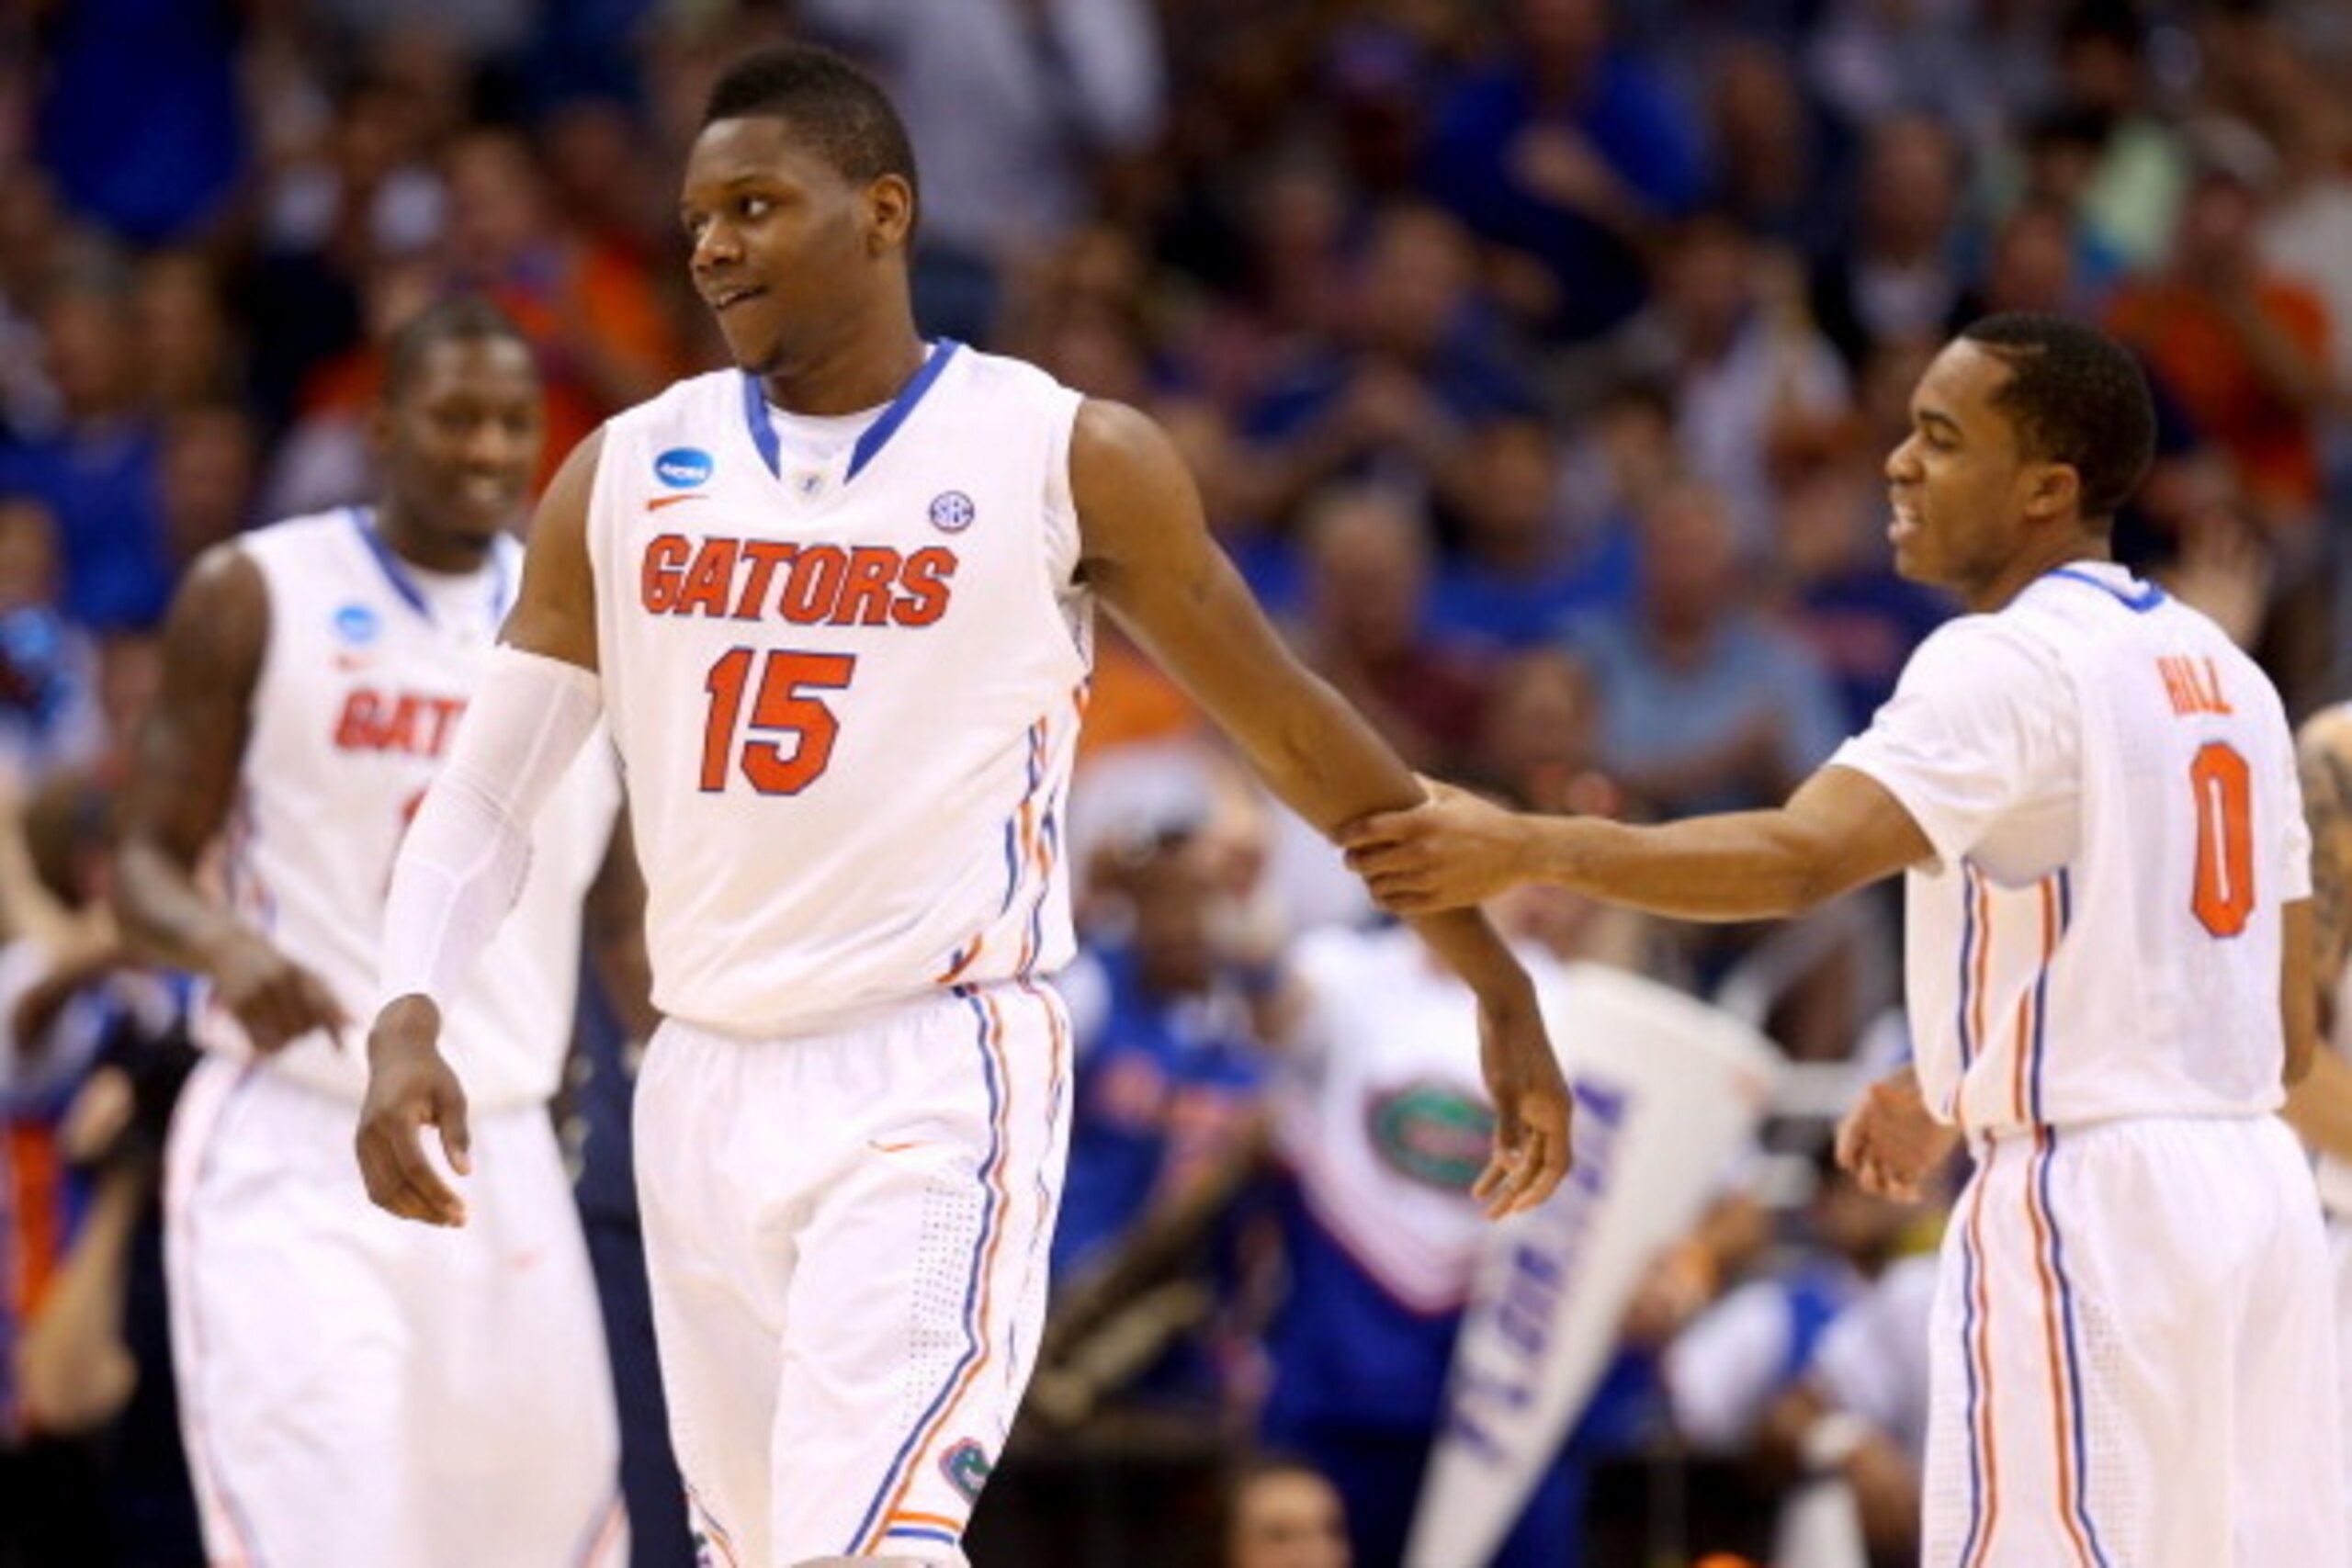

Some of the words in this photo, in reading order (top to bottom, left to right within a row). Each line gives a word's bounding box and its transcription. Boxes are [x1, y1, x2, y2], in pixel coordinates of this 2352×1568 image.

[640, 533, 959, 626] GATORS
[699, 645, 856, 795] 15
[2156, 656, 2233, 715] HILL
[2190, 740, 2254, 937] 0
